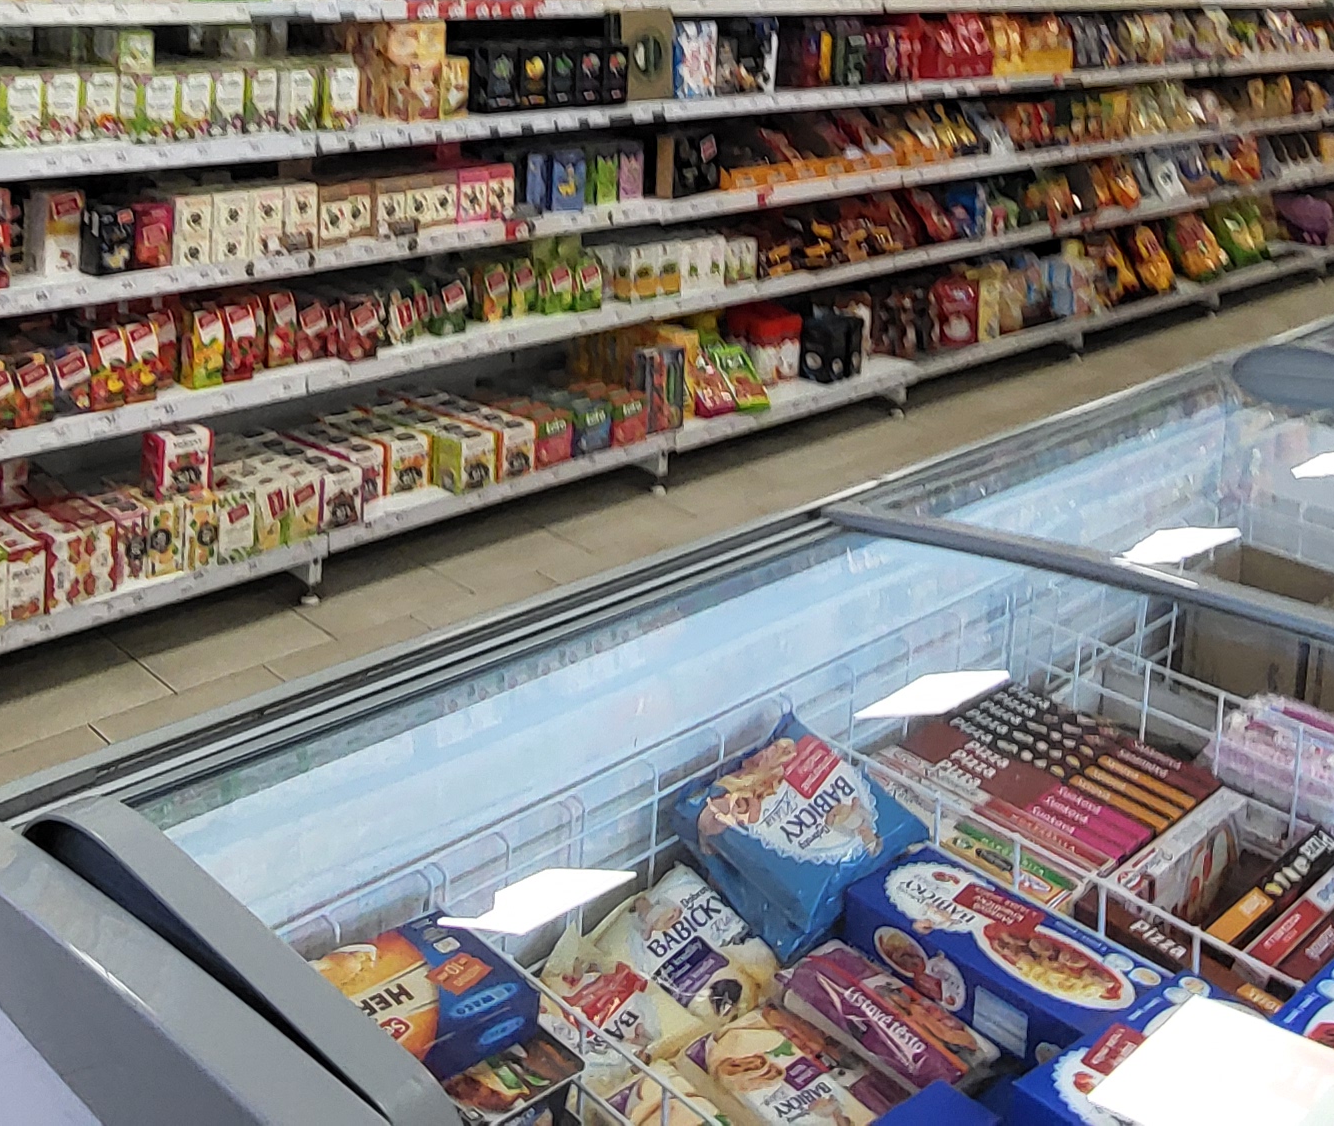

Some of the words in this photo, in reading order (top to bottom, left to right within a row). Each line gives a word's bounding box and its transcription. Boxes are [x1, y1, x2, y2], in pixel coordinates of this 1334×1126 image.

[935, 758, 982, 788] Pizza
[950, 749, 997, 779] Pizza
[964, 740, 1010, 769] Pizza
[779, 774, 856, 845] BABIČKY
[646, 895, 723, 959] BABIČKY
[1129, 919, 1188, 961] Pizza
[843, 986, 894, 1029] Listové
[888, 1020, 928, 1054] těsto
